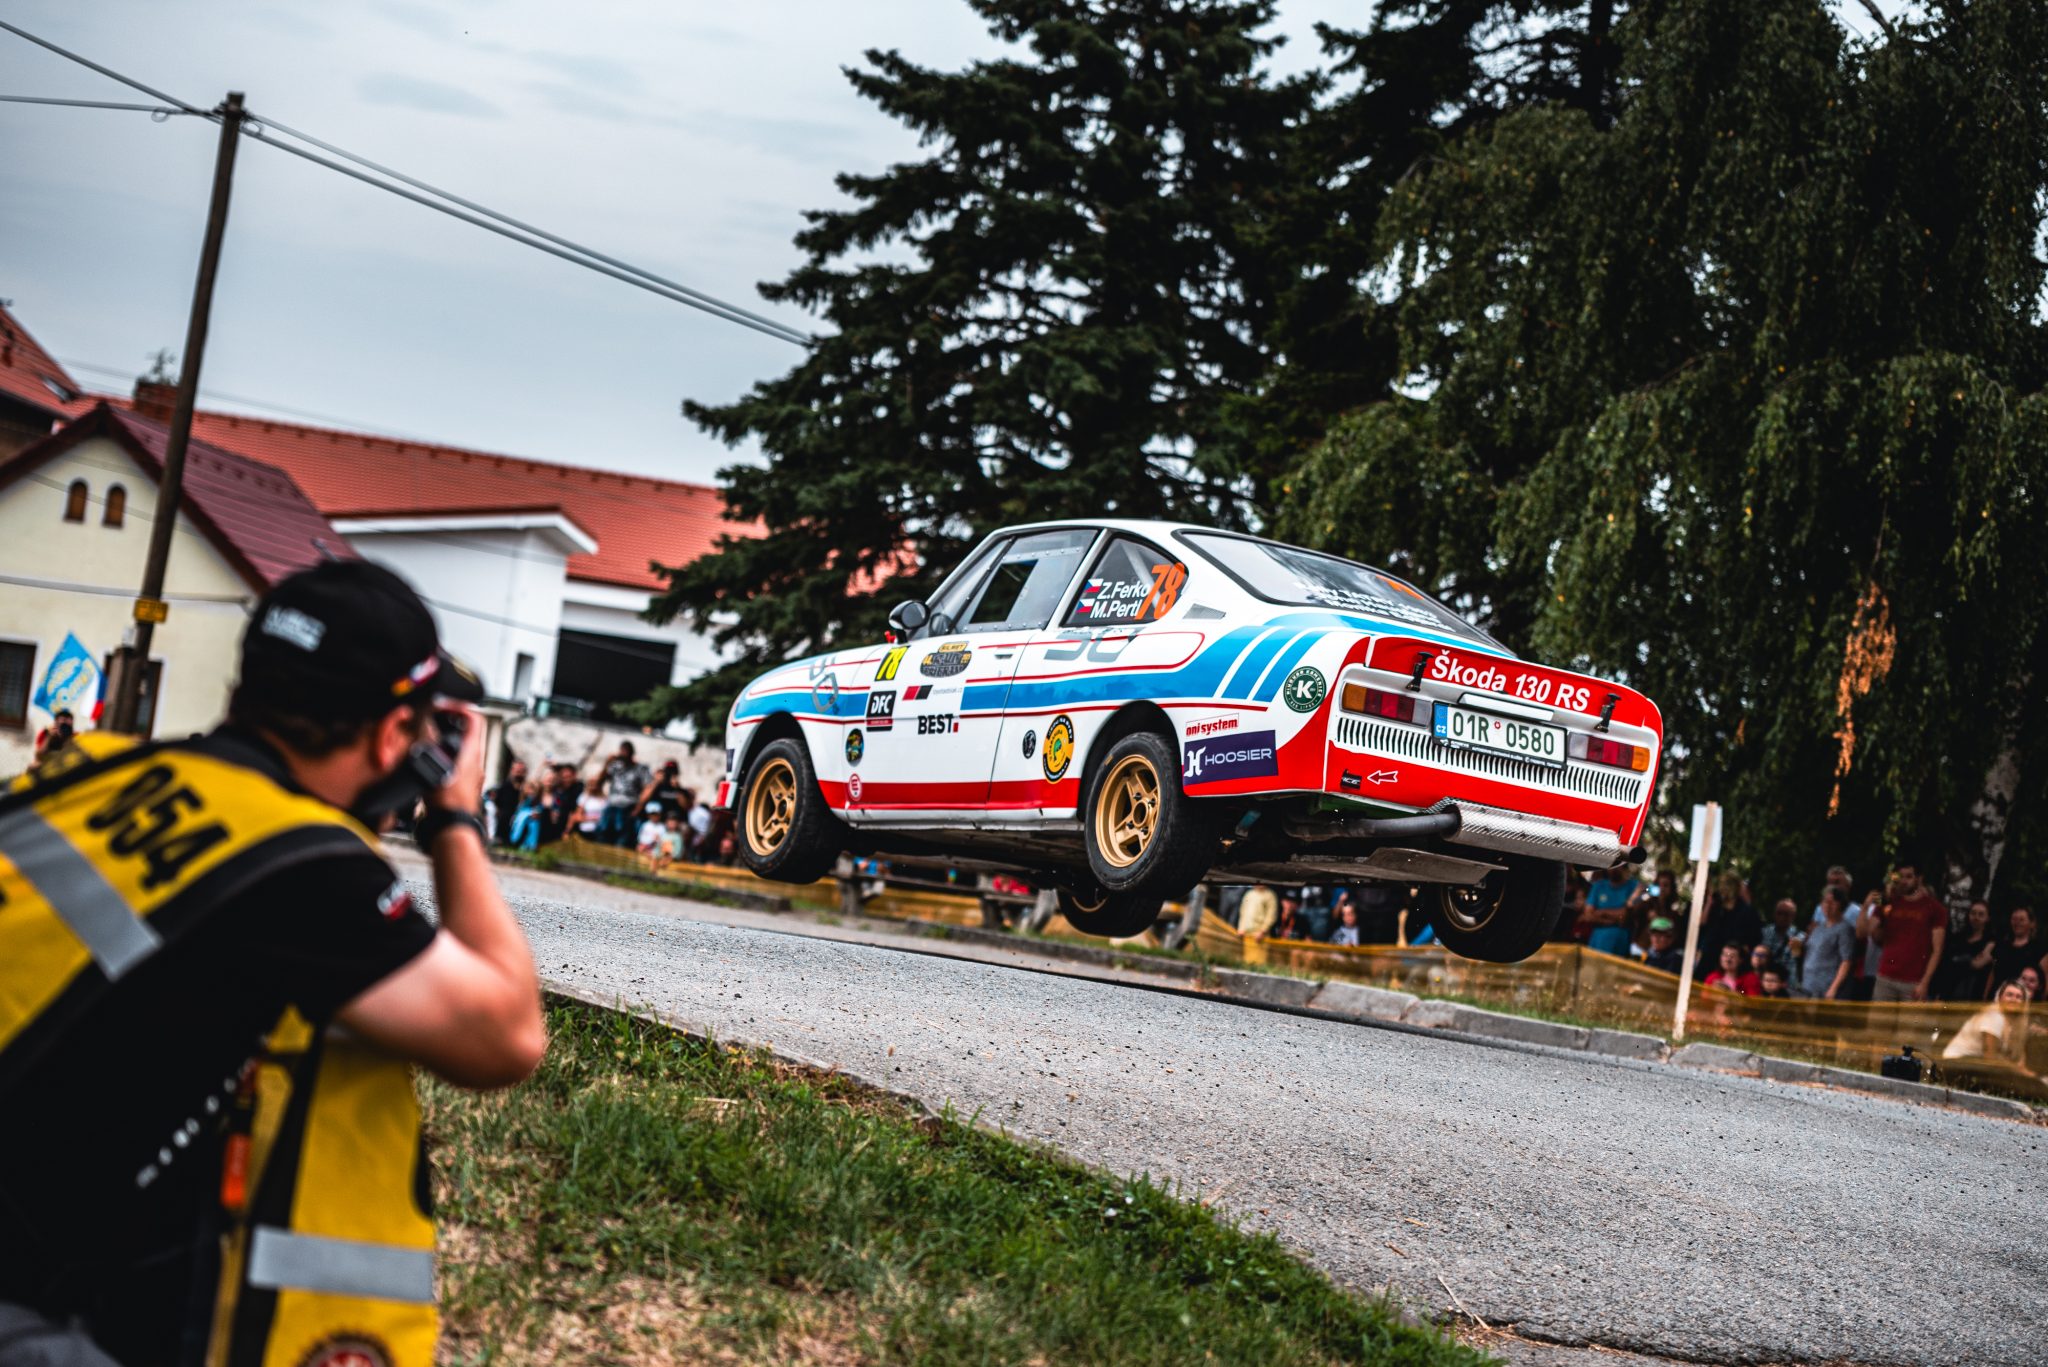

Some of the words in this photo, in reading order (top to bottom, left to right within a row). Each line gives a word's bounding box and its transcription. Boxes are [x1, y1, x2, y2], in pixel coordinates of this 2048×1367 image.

[1097, 580, 1151, 600] Z.Ferko
[1134, 562, 1185, 620] 78
[1090, 599, 1143, 618] M.Pertl
[876, 646, 908, 680] 78
[1296, 680, 1315, 699] K
[1431, 649, 1507, 691] Škoda
[1515, 673, 1551, 703] 130
[1554, 683, 1591, 712] RS
[1436, 725, 1447, 734] CZ
[1453, 711, 1489, 743] 01R
[1506, 722, 1554, 756] 0580
[1205, 748, 1272, 765] HOOSIER
[86, 764, 231, 892] 954
